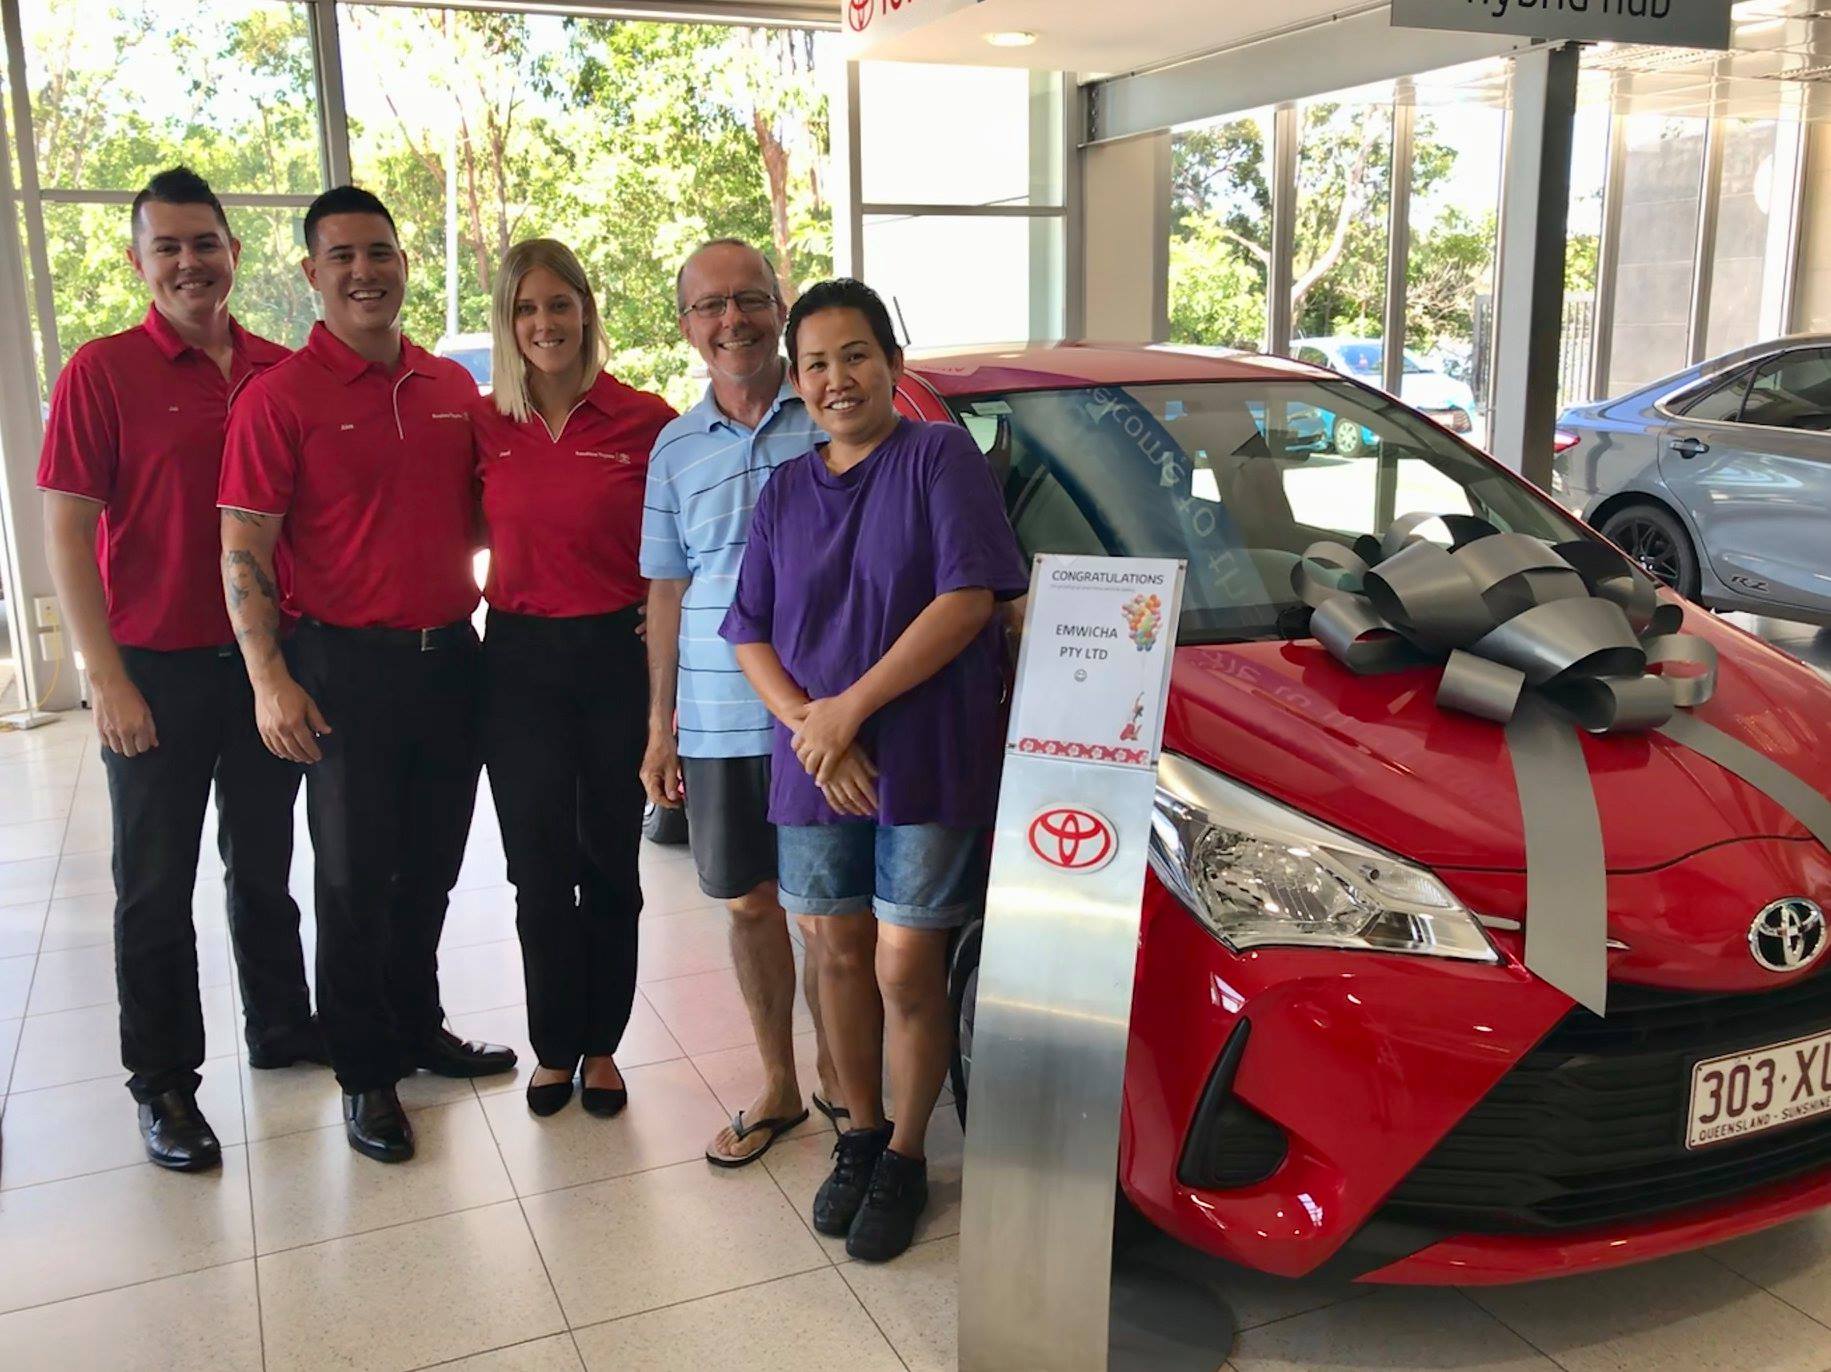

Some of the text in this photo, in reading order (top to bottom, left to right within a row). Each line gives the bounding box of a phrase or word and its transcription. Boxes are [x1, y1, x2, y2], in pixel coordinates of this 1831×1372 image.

[1051, 570, 1165, 585] CONGRATULATIONS
[1056, 624, 1118, 639] EMWICHA
[1059, 647, 1109, 661] PTY LTD
[1698, 1114, 1771, 1142] QUEENSLAND
[1781, 1095, 1831, 1121] SUNSHINE
